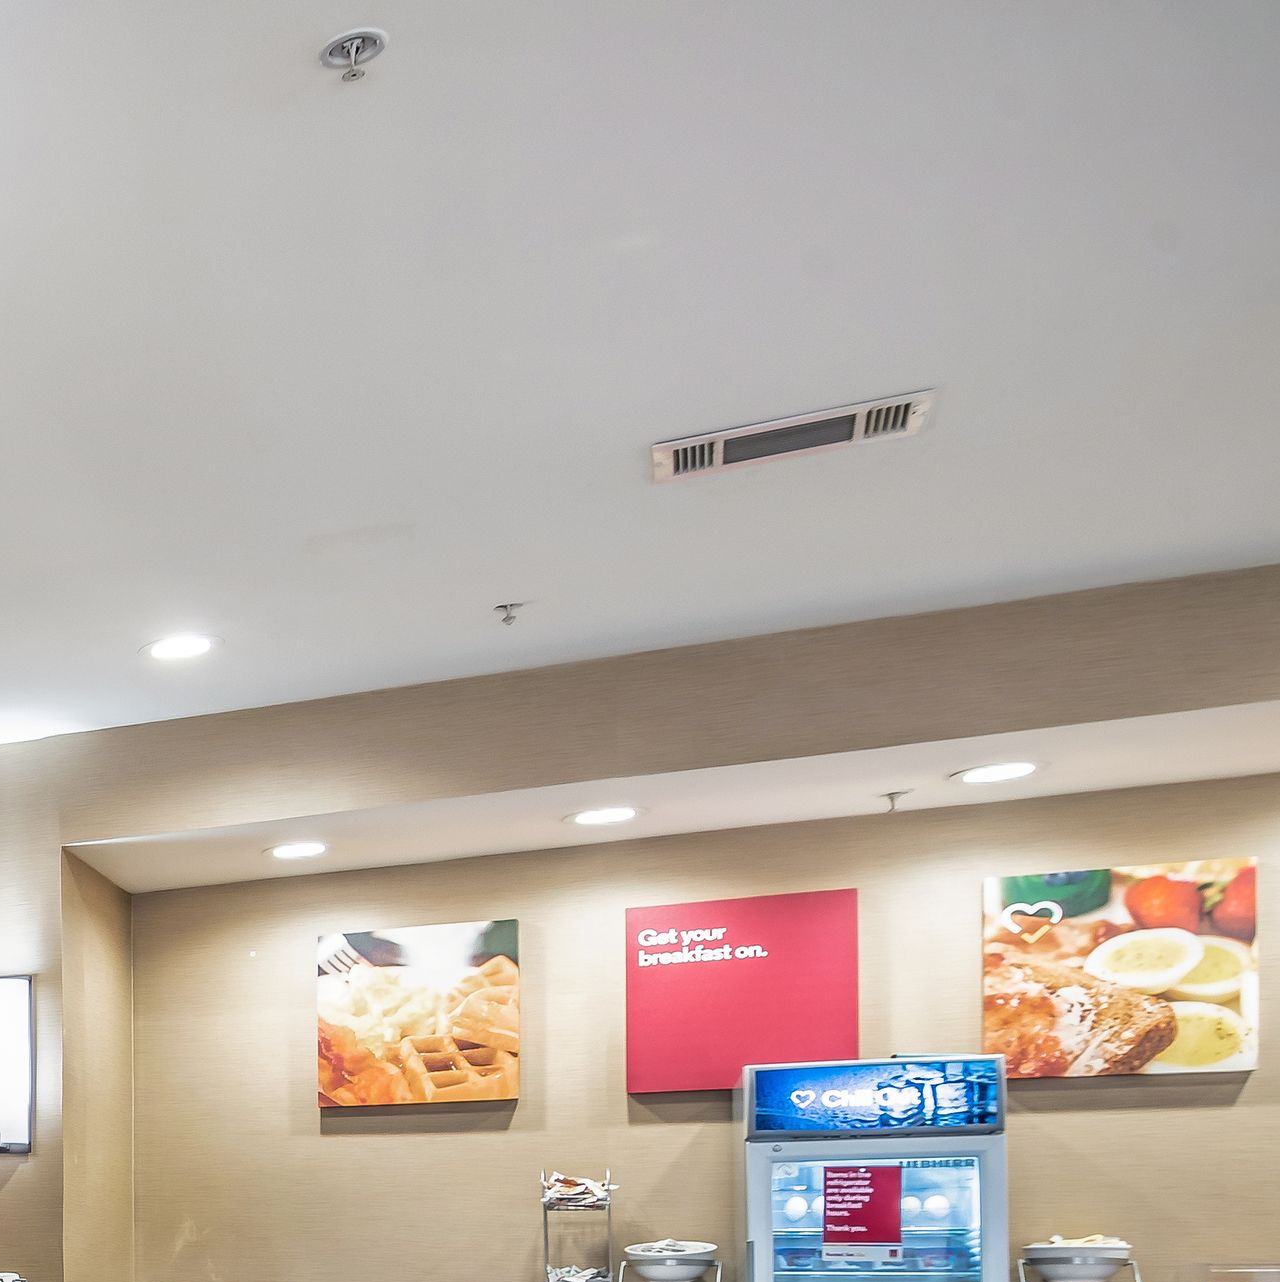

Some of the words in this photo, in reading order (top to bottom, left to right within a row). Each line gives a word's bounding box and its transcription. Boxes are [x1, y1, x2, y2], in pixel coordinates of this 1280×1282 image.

[638, 928, 678, 947] Get
[680, 927, 727, 947] your
[638, 944, 733, 967] breakfast
[734, 945, 769, 959] on.
[821, 1089, 873, 1108] Chill
[875, 1087, 921, 1106] Out
[899, 1159, 975, 1169] LIEBHERR
